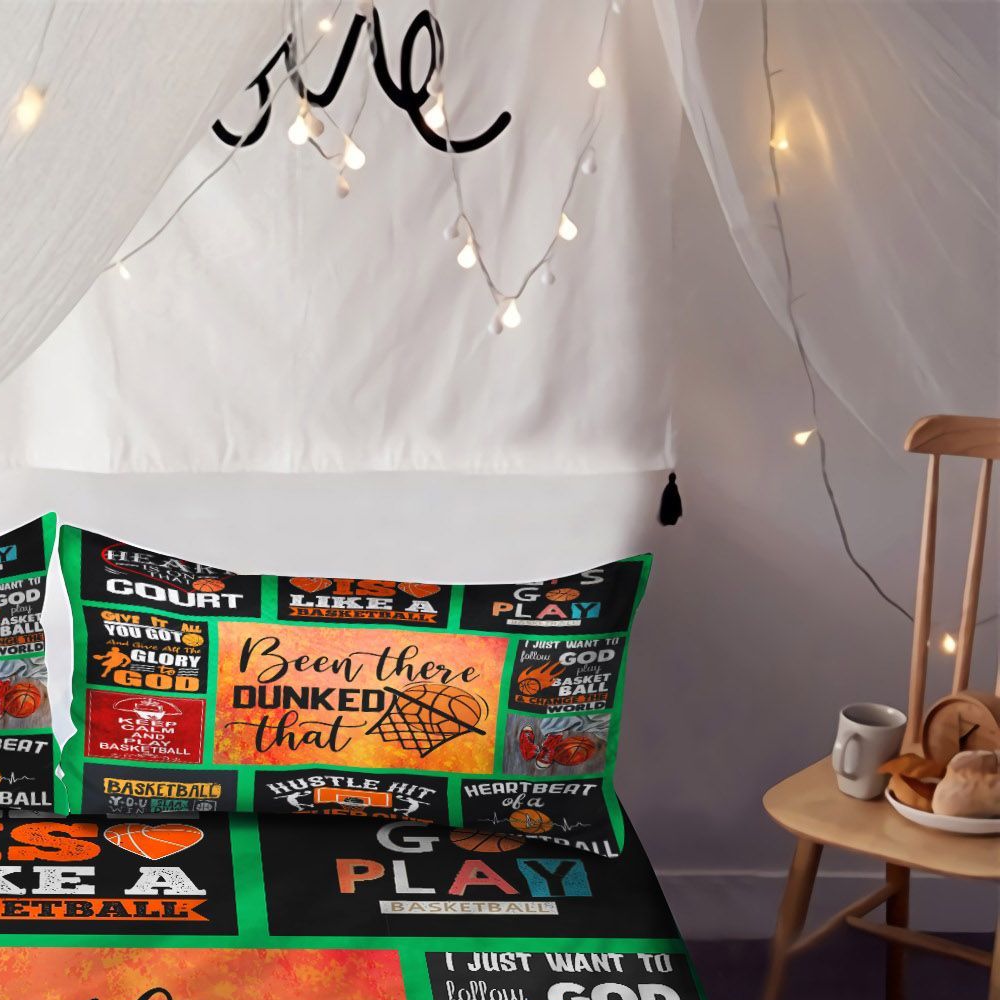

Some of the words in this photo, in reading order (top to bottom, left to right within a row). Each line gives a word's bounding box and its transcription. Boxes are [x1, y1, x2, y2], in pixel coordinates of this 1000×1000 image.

[106, 578, 243, 609] COURT
[333, 578, 396, 597] IS
[11, 604, 32, 616] play
[289, 594, 393, 610] LIKE
[405, 600, 438, 614] A
[492, 601, 601, 619] PLAY
[0, 622, 44, 637] BALL
[104, 624, 141, 639] YOU
[145, 627, 183, 643] GOT
[533, 640, 560, 649] JUST
[566, 639, 599, 649] WANT
[130, 649, 201, 668] GLORY
[239, 636, 363, 684] Been
[349, 645, 480, 684] there
[520, 650, 550, 662] follow
[558, 649, 616, 666] GOD
[113, 669, 199, 692] GOD
[552, 673, 611, 687] BASKET
[558, 682, 609, 697] BALL
[232, 685, 386, 713] DUNKED
[547, 702, 605, 714] WORLD
[118, 717, 177, 727] KEEP
[121, 724, 175, 734] CALM
[131, 732, 165, 740] AND
[224, 710, 367, 752] that
[99, 742, 191, 756] BASKETBALL
[124, 738, 171, 746] PLAY
[107, 780, 218, 798] BASKETBALL
[266, 775, 380, 795] HUSTLE
[387, 781, 437, 800] HIT
[464, 782, 598, 798] HEARTBEAT
[502, 793, 527, 809] of
[527, 797, 545, 808] a
[124, 866, 207, 895] A
[336, 858, 593, 898] PLAY
[391, 901, 550, 913] BASKETBALL
[445, 952, 454, 972] I
[467, 952, 532, 972] JUST
[544, 952, 624, 973] WANT
[638, 953, 673, 973] TO
